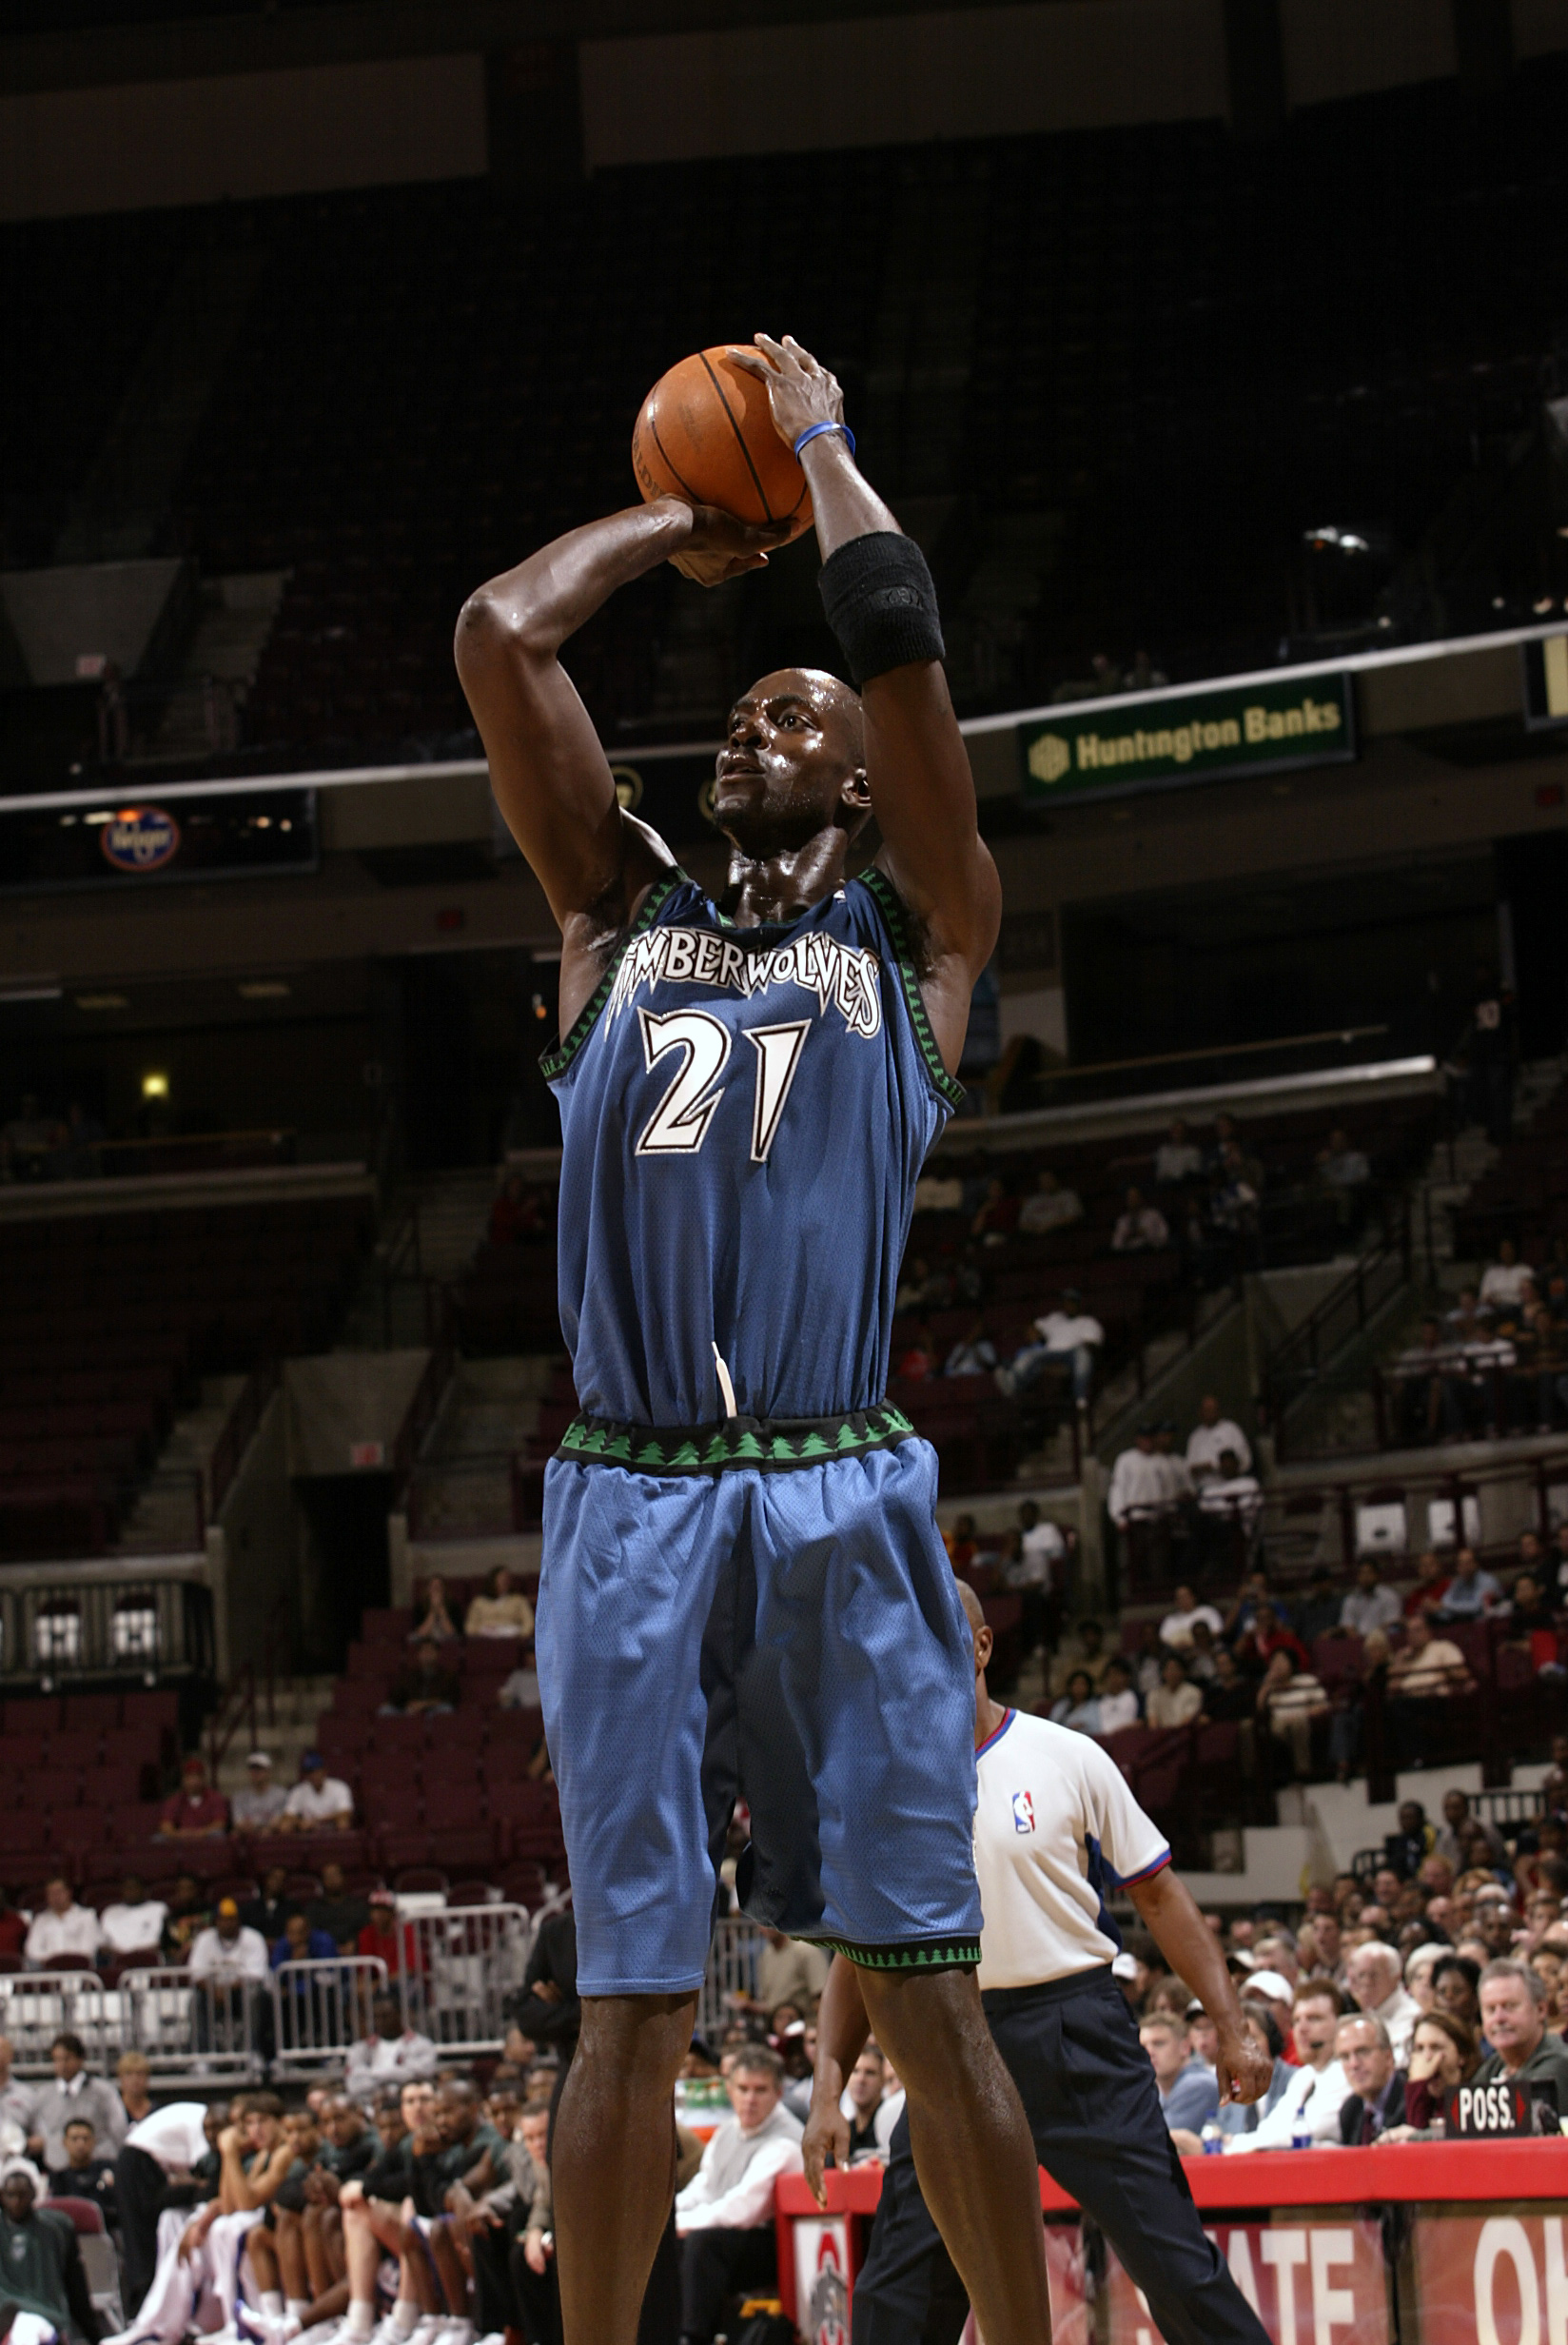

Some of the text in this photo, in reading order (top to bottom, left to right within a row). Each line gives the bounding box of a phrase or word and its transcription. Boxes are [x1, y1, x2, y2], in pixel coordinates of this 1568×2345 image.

[1076, 699, 1342, 769] Huntington Banks
[635, 1005, 812, 1162] 21
[1459, 2085, 1516, 2133] POSS.
